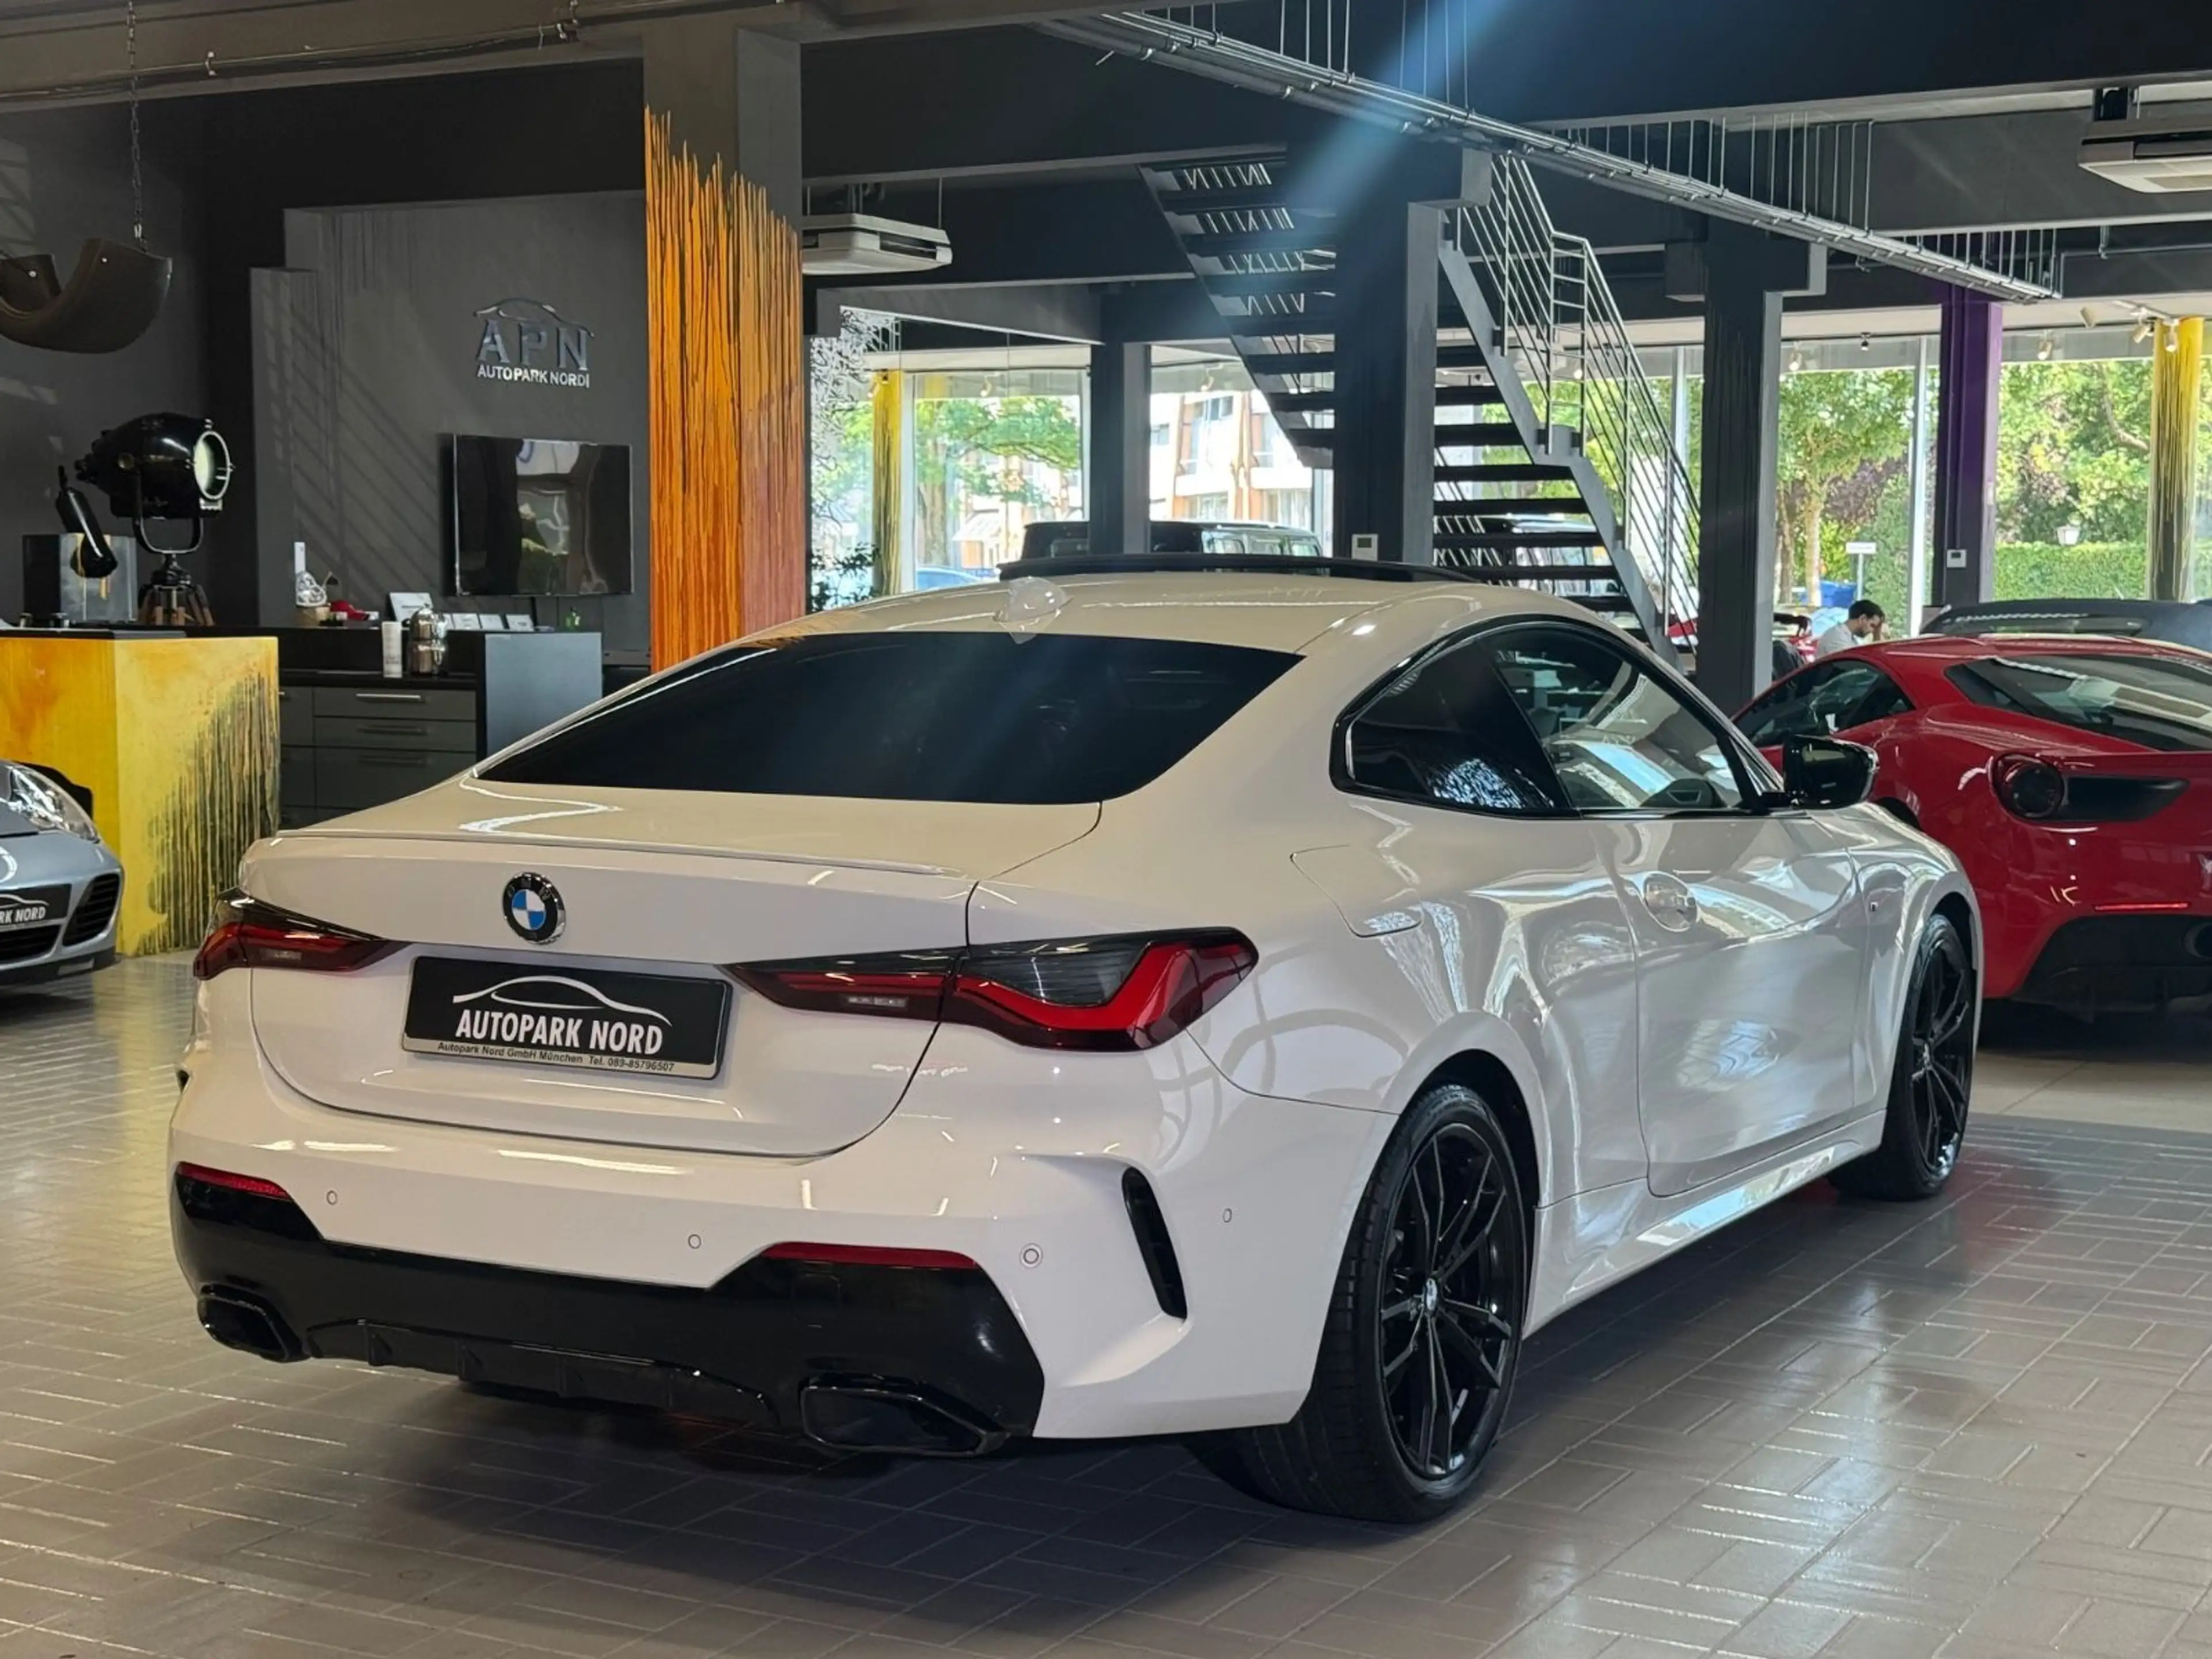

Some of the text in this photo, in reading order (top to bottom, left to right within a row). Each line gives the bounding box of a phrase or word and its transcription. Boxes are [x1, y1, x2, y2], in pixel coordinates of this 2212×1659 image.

[476, 319, 589, 371] APN
[477, 365, 548, 384] AUTOPARK
[15, 906, 47, 922] NORD
[455, 1009, 663, 1055] AUTOPARK NORD
[437, 1042, 479, 1055] Autopark
[482, 1047, 505, 1057] Nord
[507, 1048, 536, 1059] GmbH
[539, 1051, 583, 1063] München
[589, 1056, 605, 1065] Tel.
